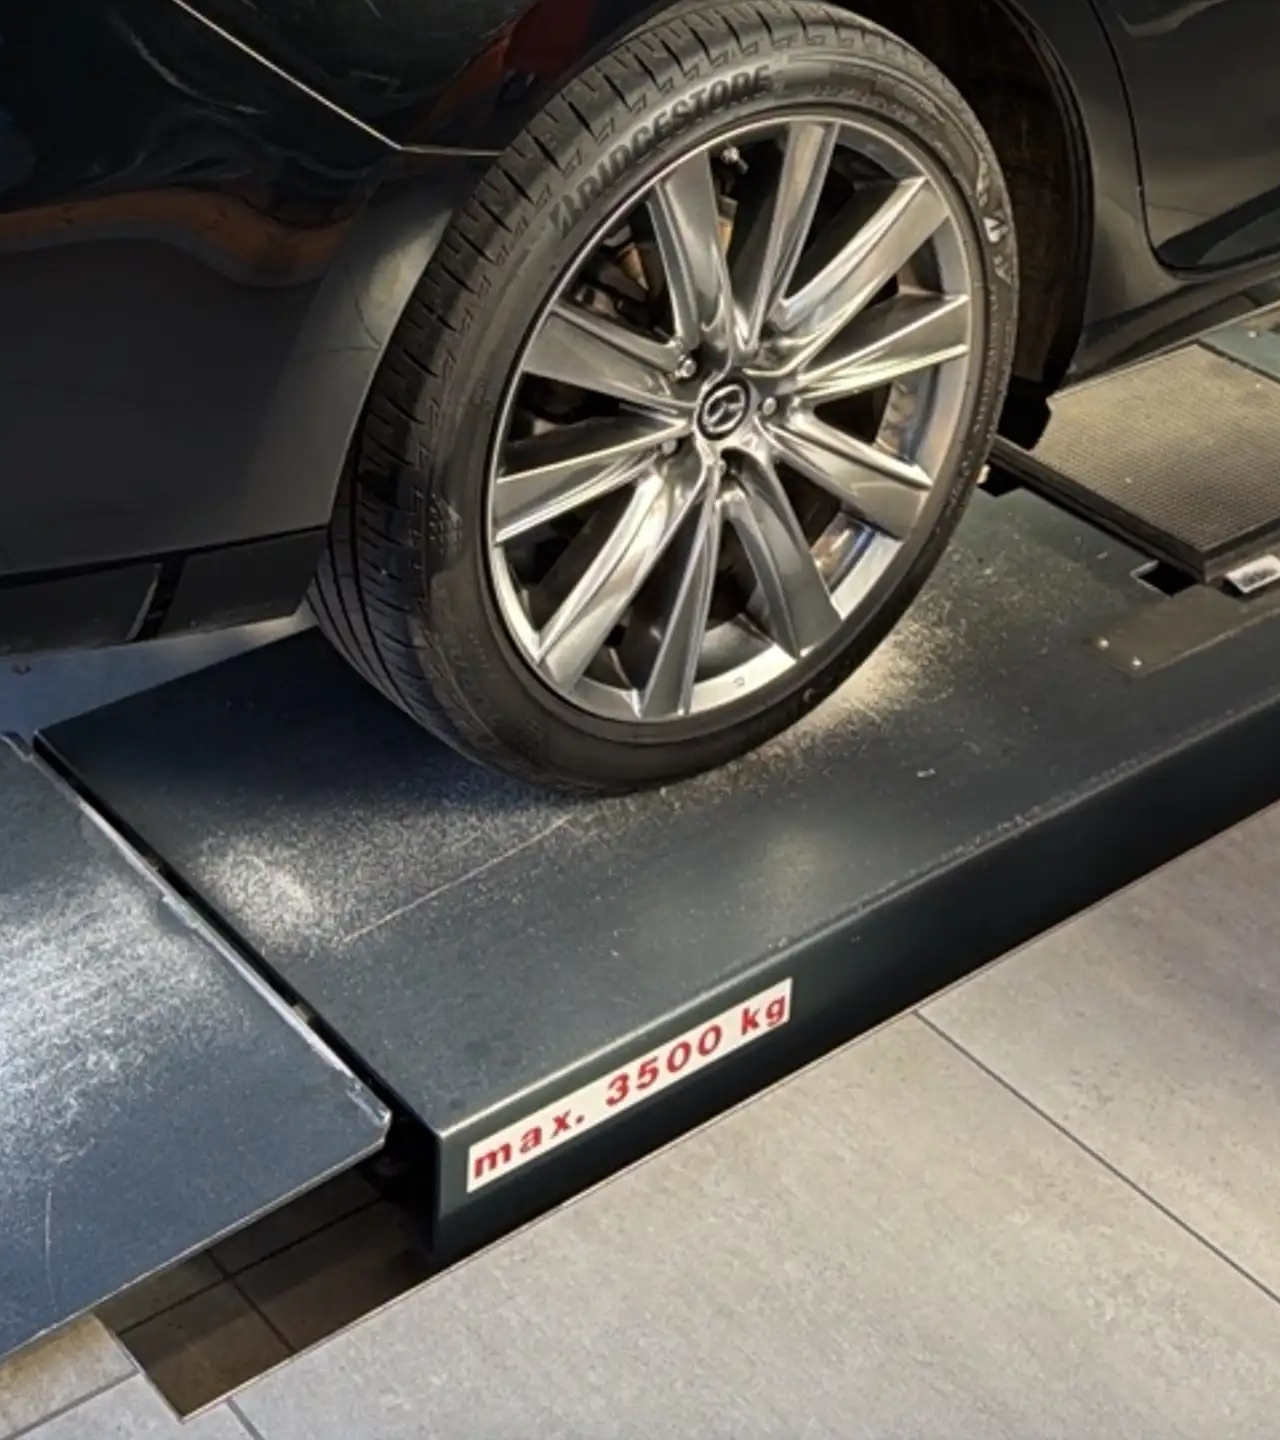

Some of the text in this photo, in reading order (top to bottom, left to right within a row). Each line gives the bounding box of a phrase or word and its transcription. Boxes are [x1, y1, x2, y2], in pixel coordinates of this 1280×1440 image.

[473, 994, 786, 1181] max. 3500 kg
